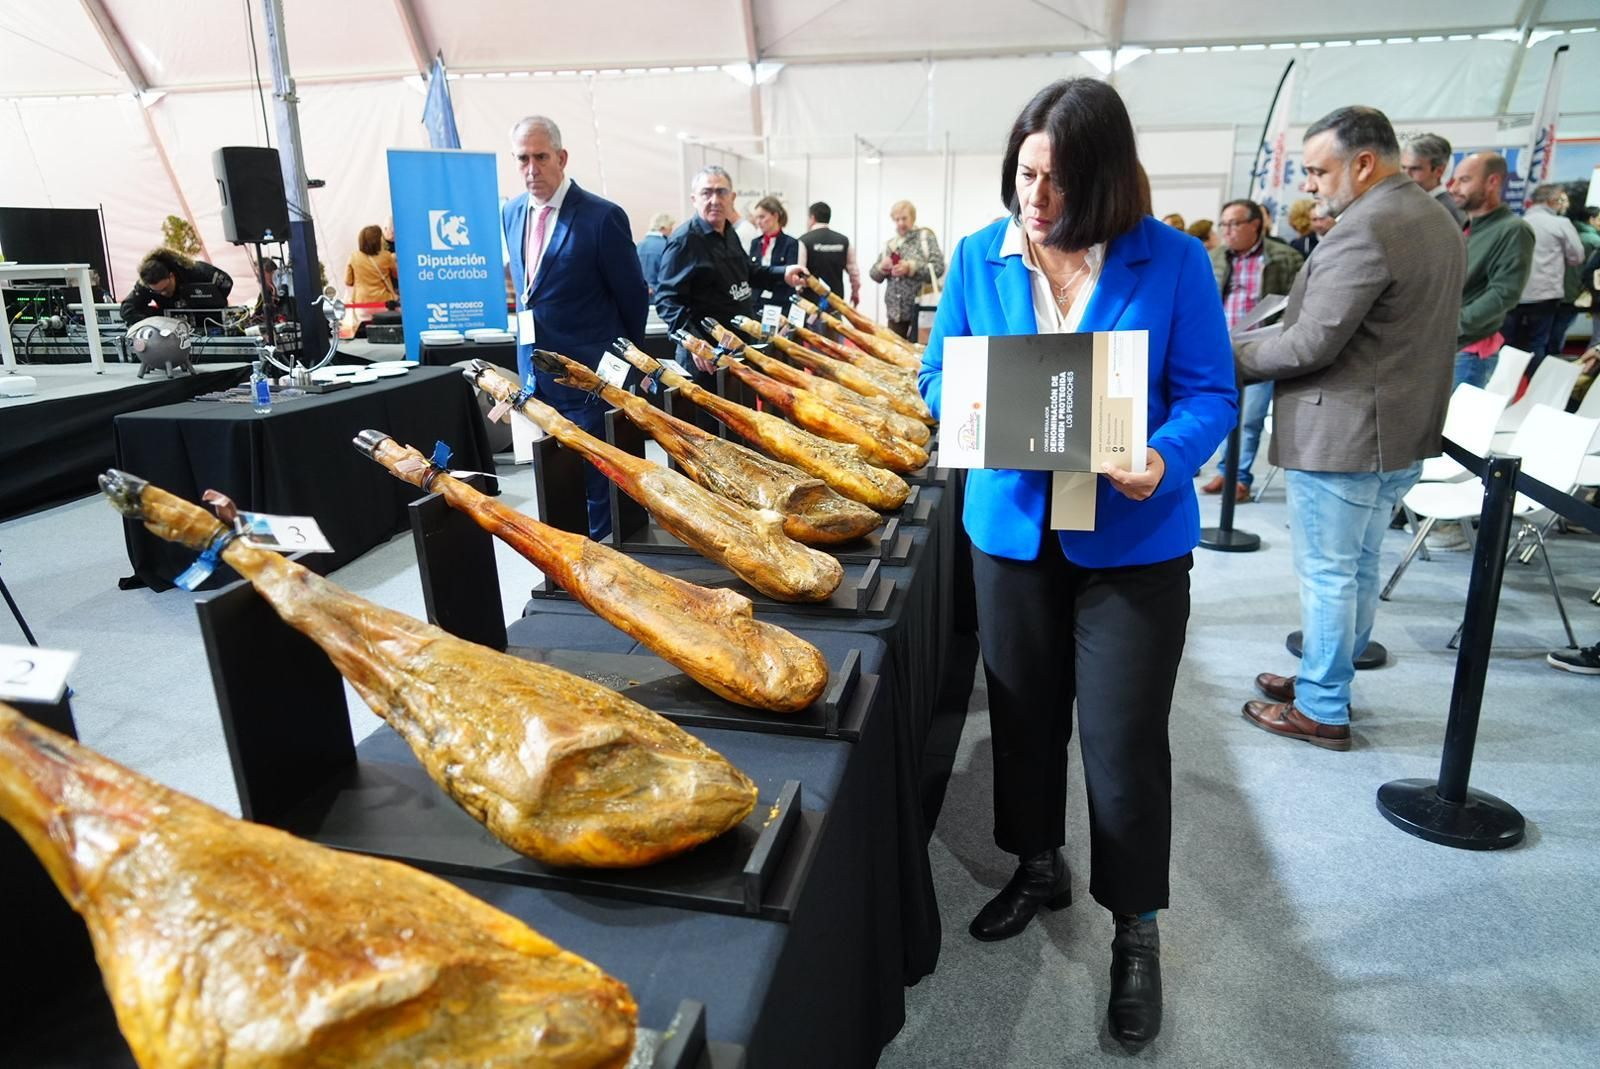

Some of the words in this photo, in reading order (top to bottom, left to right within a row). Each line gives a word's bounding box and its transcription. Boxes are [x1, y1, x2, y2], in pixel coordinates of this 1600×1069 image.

[417, 253, 485, 268] Diputación
[418, 269, 434, 281] de
[438, 267, 488, 280] Córdoba
[1051, 376, 1058, 387] DE
[1050, 390, 1058, 452] DENOMINACIÓN
[287, 525, 307, 544] 3
[3, 659, 36, 686] 2
